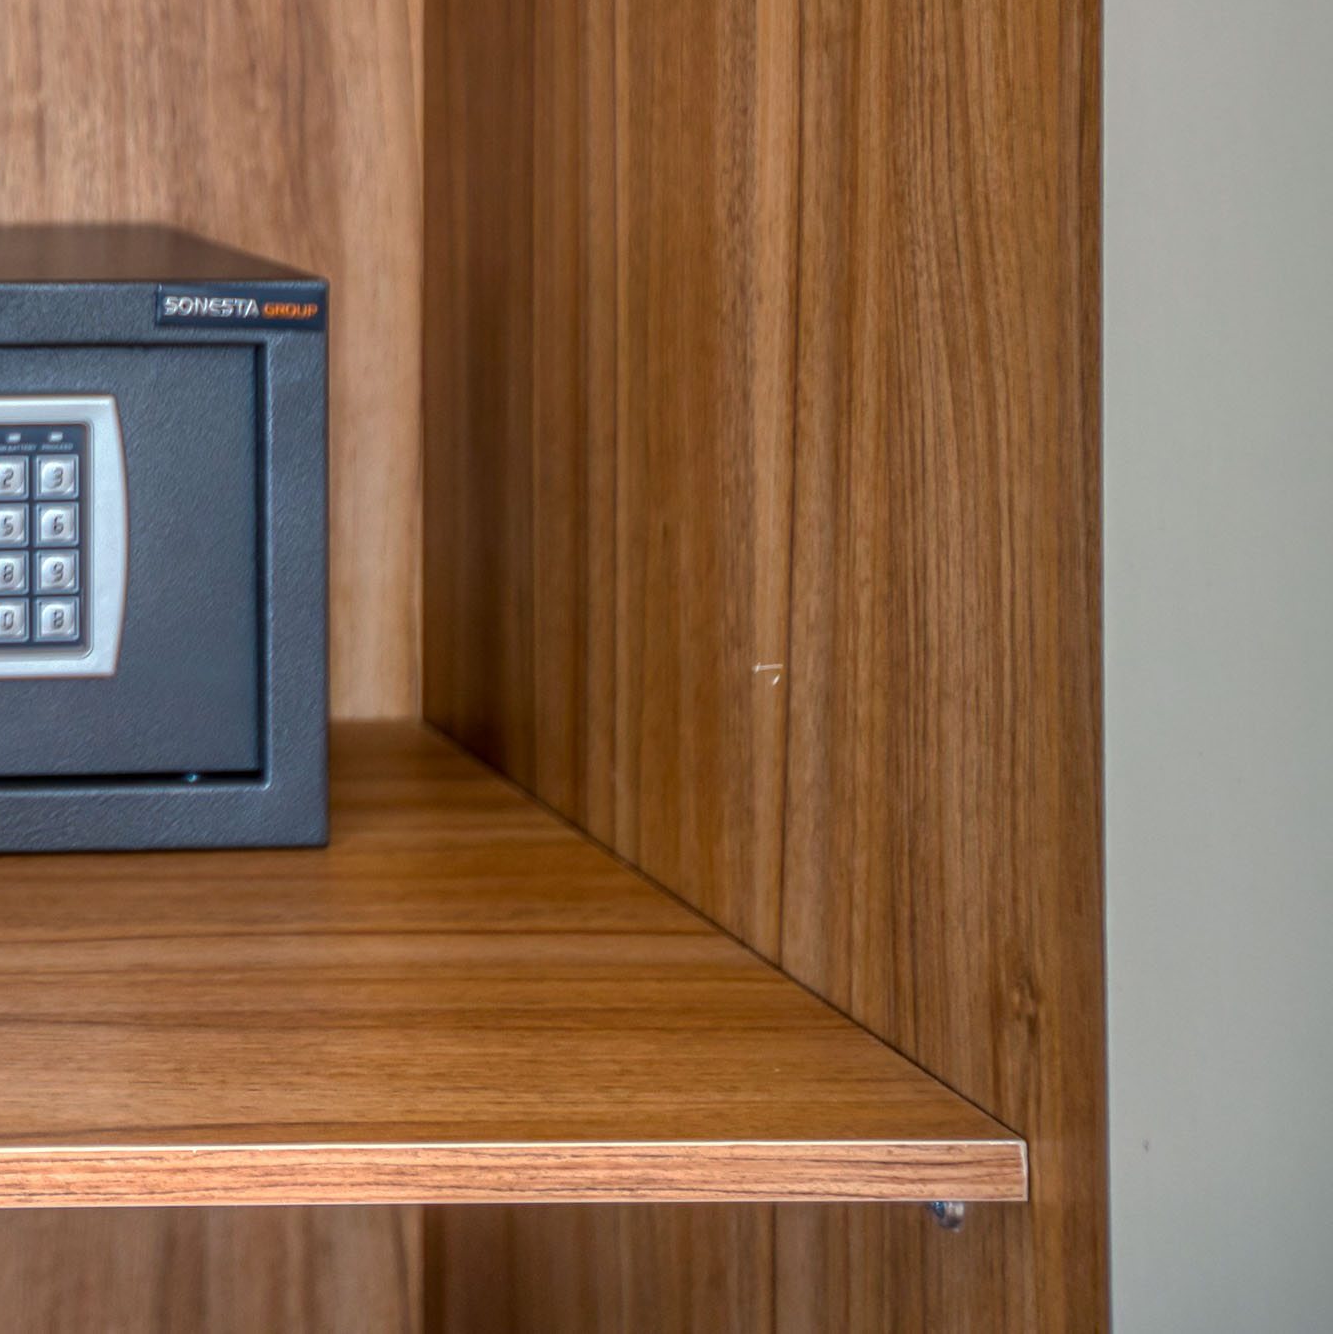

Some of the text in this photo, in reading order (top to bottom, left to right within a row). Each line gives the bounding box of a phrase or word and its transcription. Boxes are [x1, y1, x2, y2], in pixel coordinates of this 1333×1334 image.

[163, 295, 318, 319] SONESTA GROUP
[2, 468, 14, 489] 2
[52, 467, 64, 488] 3
[2, 515, 14, 537] 5
[52, 514, 64, 535] 6
[2, 562, 14, 583] 8
[52, 561, 64, 582] 9
